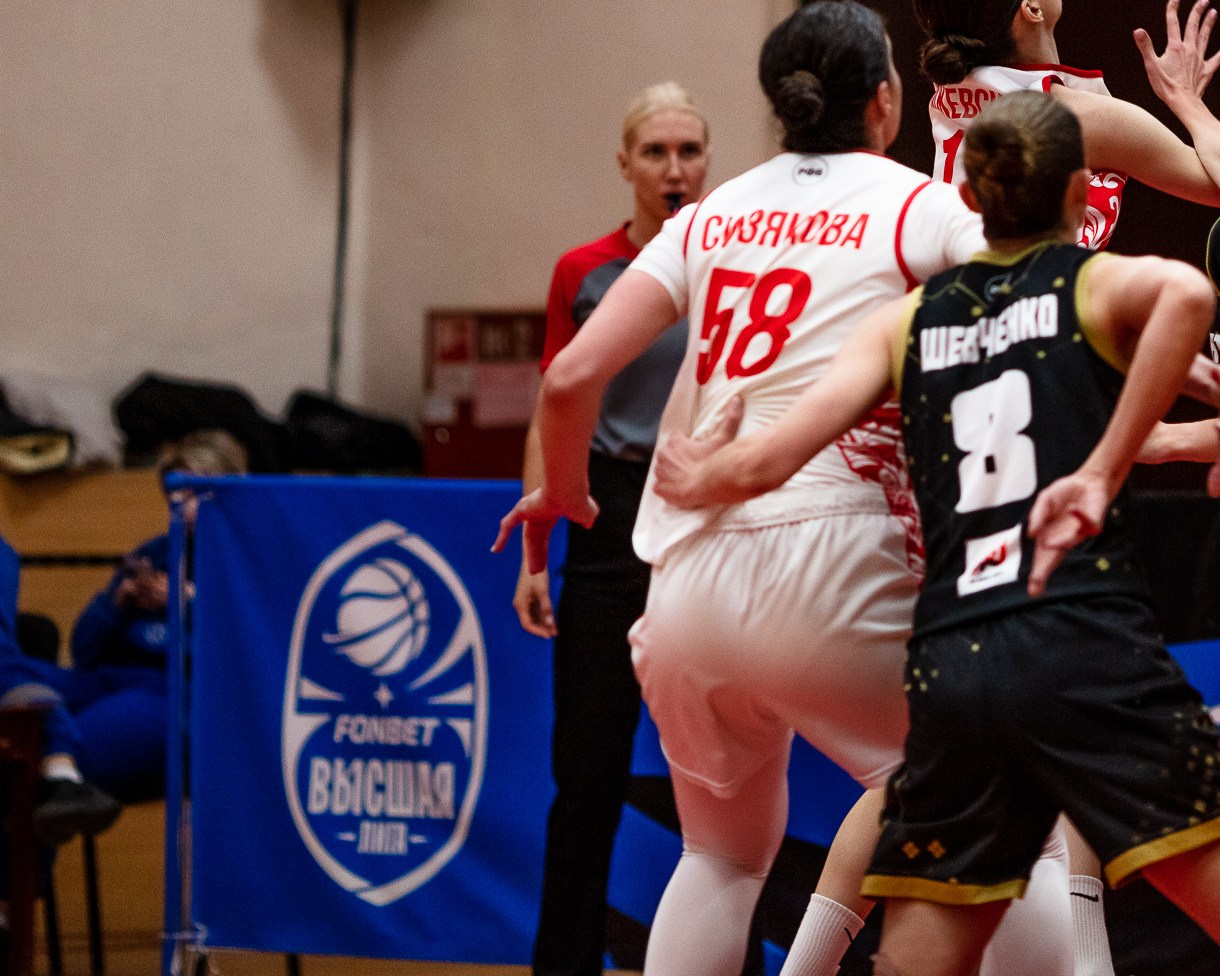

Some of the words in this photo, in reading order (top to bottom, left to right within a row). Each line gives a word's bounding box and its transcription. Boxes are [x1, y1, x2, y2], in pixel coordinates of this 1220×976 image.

[696, 267, 812, 385] 58
[951, 369, 1037, 514] 8
[334, 714, 441, 746] FONBET
[308, 756, 455, 819] ВЫСШАЯ
